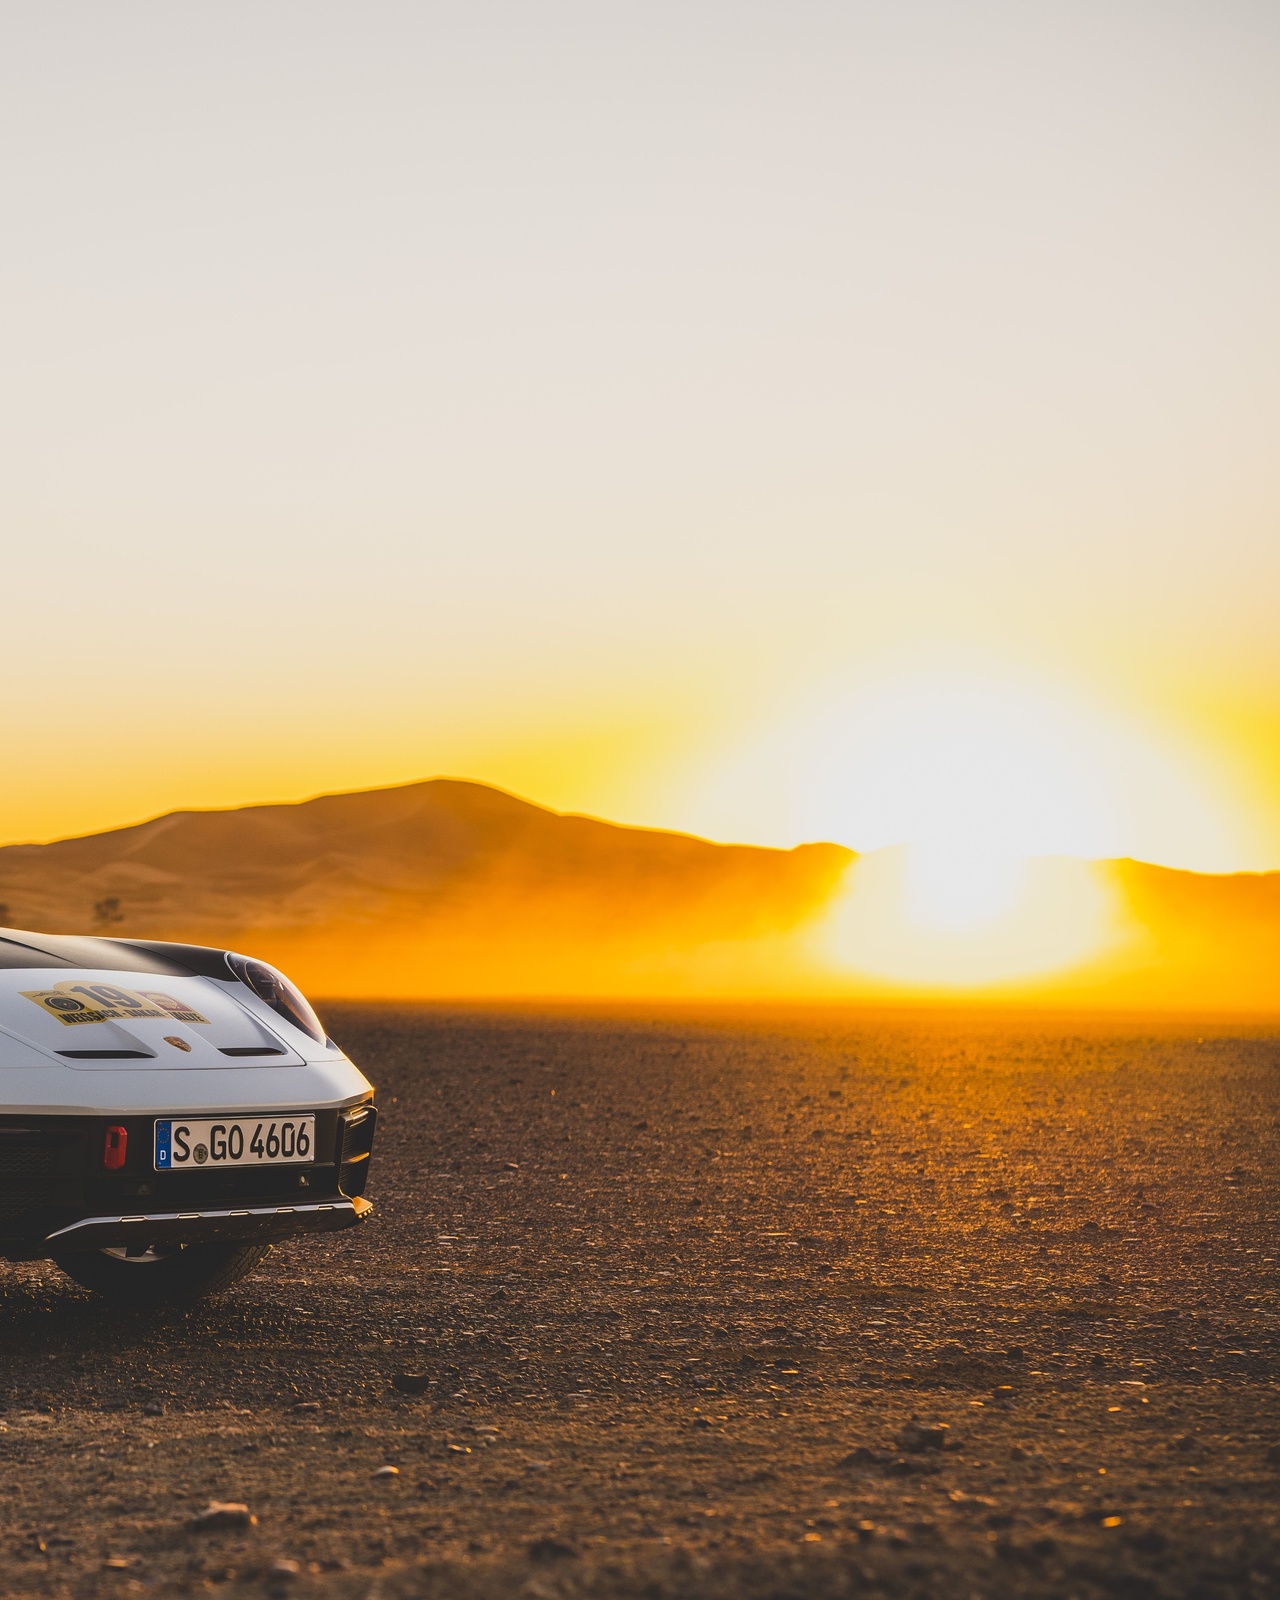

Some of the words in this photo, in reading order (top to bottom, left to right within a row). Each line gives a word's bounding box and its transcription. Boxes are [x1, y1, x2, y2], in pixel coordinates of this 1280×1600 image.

[70, 986, 142, 1008] 19
[58, 1010, 123, 1023] WEISSACH
[173, 1126, 190, 1162] S
[210, 1124, 243, 1160] GO
[250, 1122, 310, 1158] 4606
[159, 1150, 167, 1161] D
